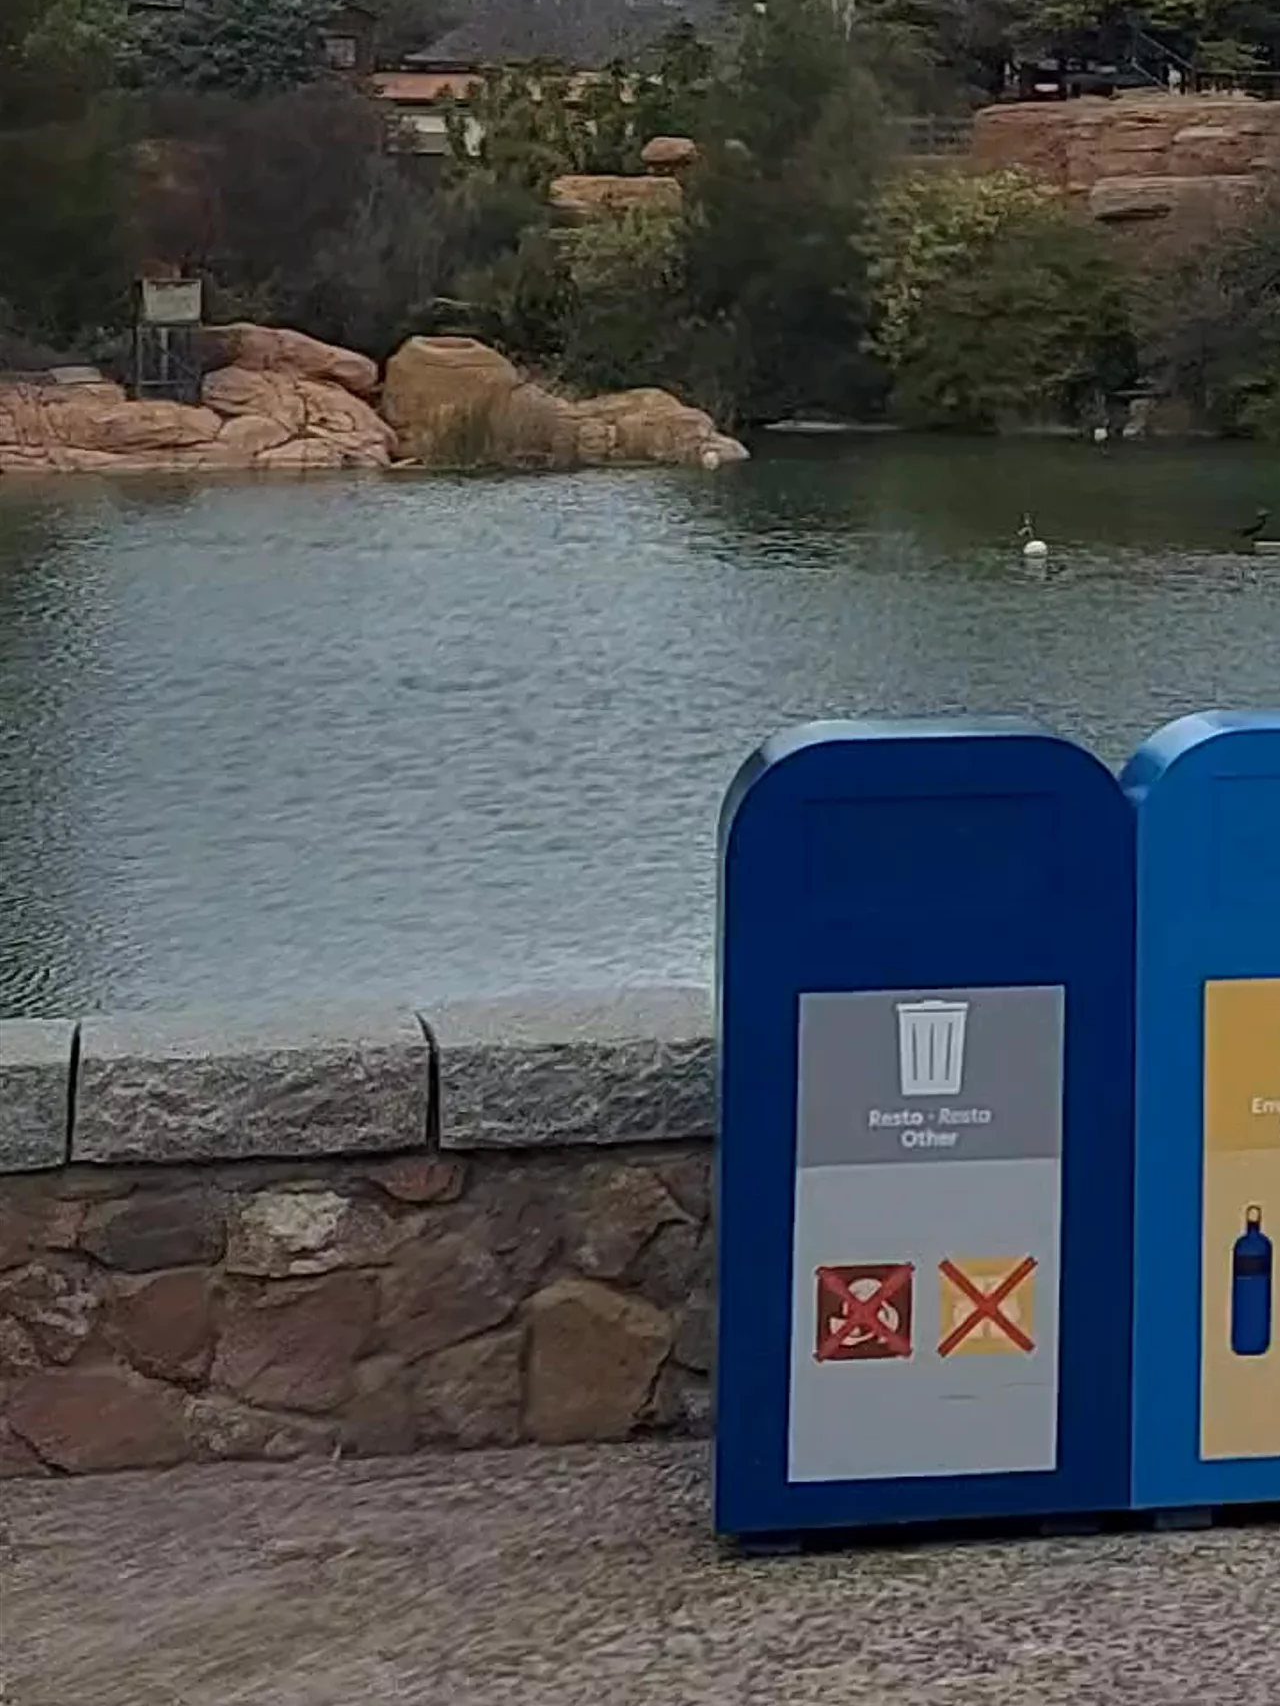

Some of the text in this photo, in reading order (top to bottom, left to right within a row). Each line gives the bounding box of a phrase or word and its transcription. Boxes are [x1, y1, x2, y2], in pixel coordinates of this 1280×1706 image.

[869, 1107, 993, 1127] Resto Resto
[901, 1128, 958, 1147] Other
